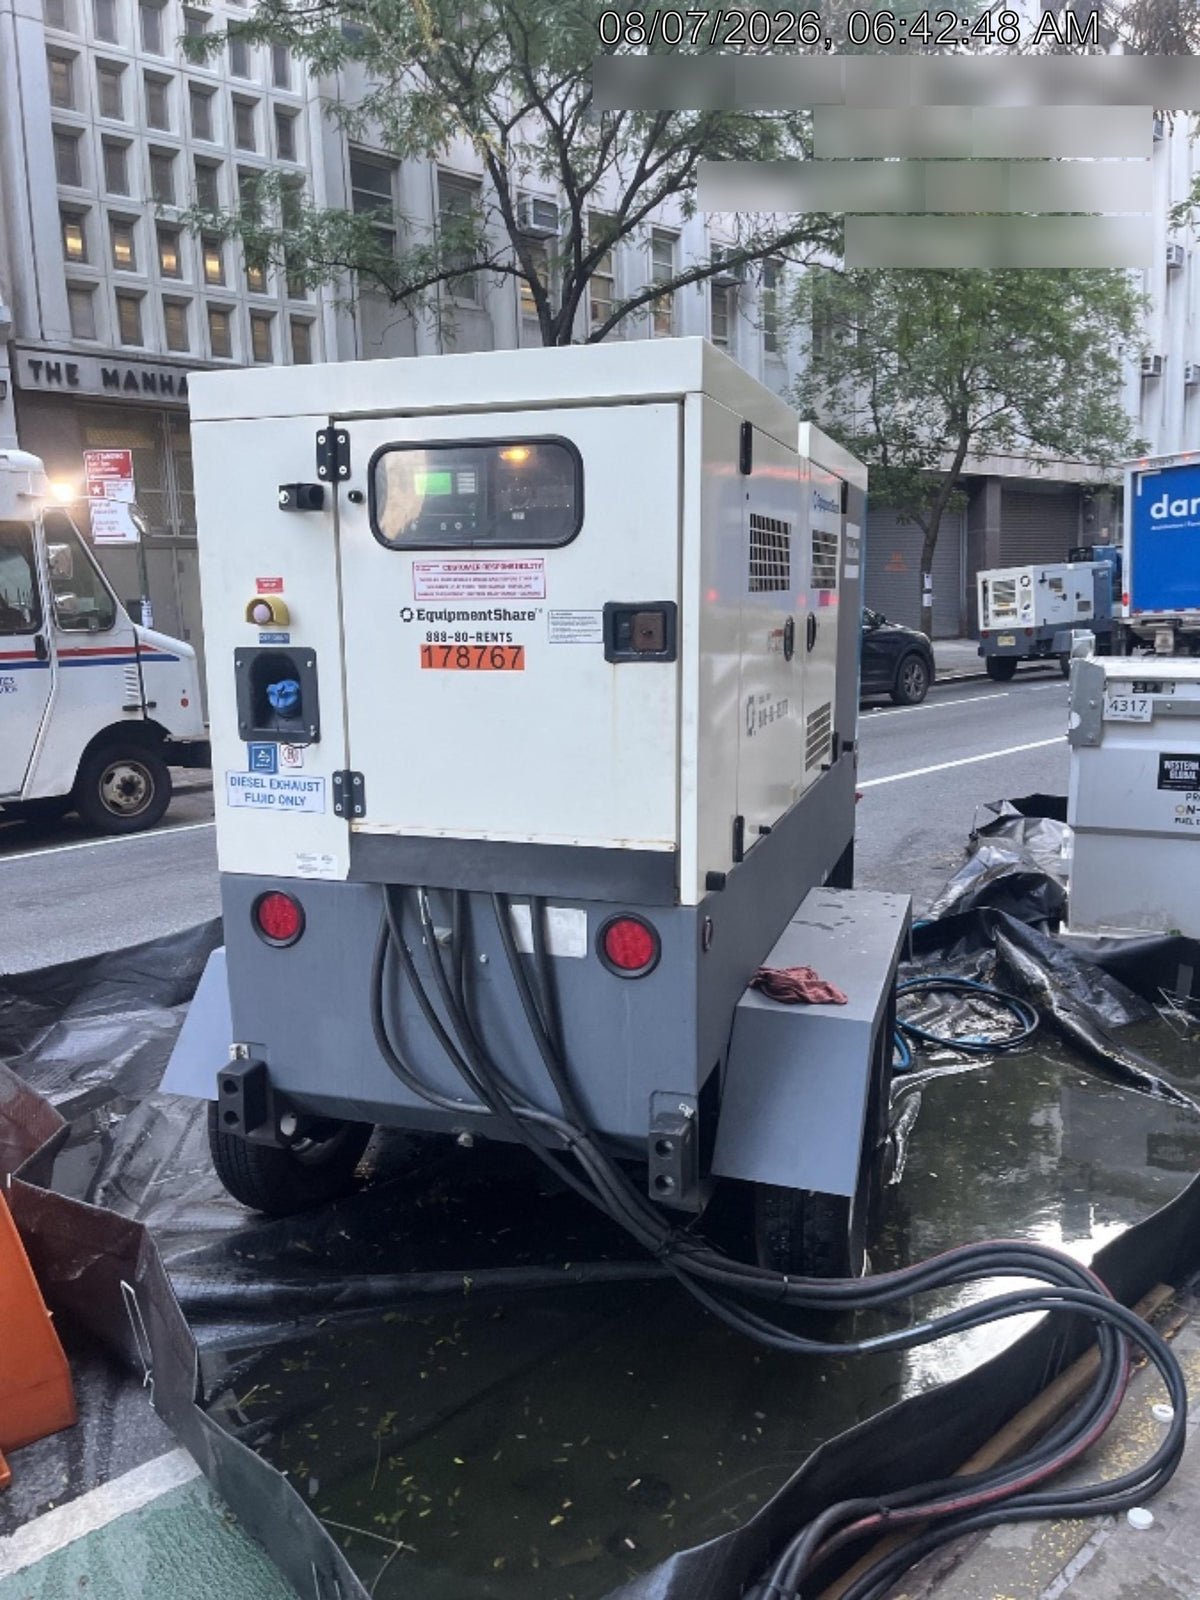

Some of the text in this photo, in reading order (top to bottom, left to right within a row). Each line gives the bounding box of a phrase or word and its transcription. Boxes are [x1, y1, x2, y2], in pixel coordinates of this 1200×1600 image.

[28, 359, 188, 397] THE MANHA
[417, 609, 536, 622] EquipmentShare
[426, 631, 513, 642] 888-80-RENTS
[422, 645, 523, 669] 178767
[1109, 700, 1148, 712] 4317
[230, 776, 321, 792] DIESEL EXHAUST
[244, 792, 306, 806] FLUID ONLY
